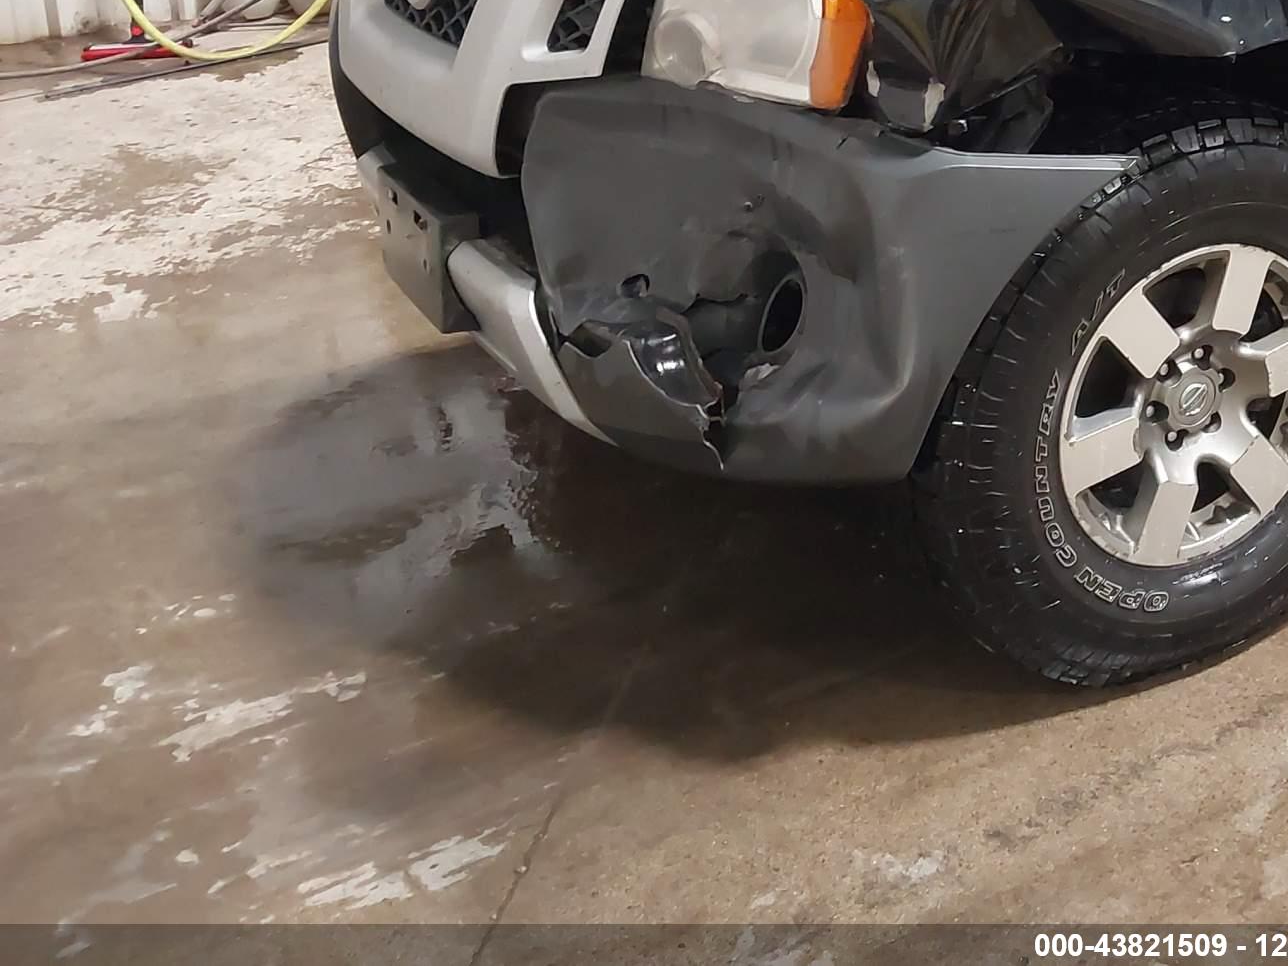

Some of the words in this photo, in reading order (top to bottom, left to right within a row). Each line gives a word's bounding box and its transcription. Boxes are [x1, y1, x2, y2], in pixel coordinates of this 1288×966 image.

[1069, 268, 1126, 356] A/T
[1032, 369, 1080, 571] COUNTRY
[1074, 566, 1170, 613] OPEN
